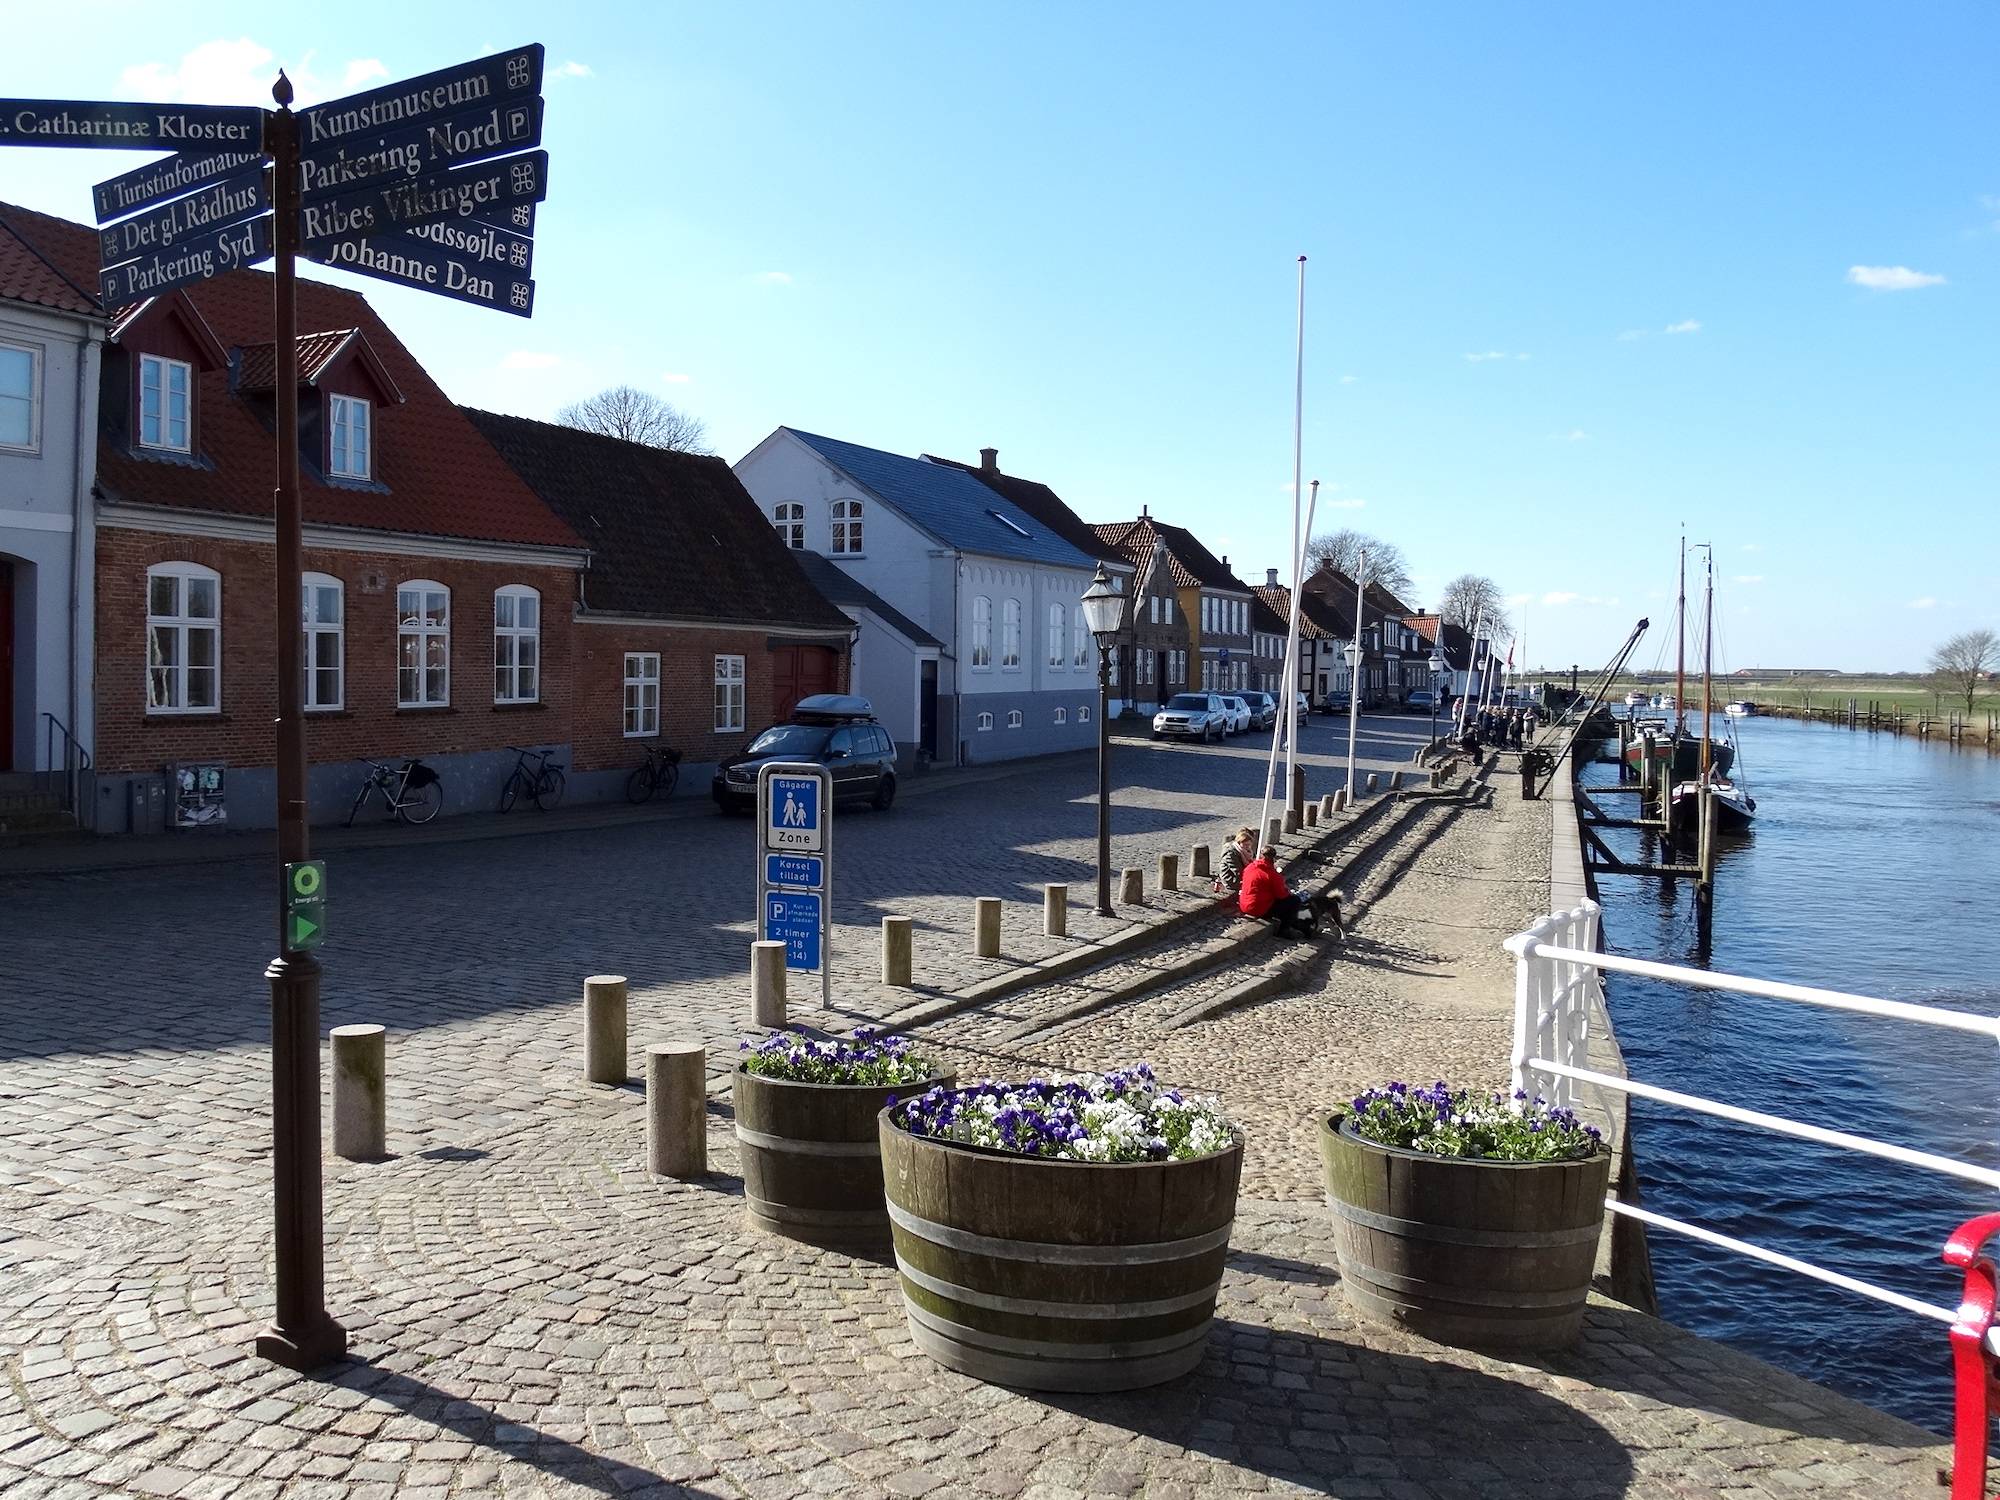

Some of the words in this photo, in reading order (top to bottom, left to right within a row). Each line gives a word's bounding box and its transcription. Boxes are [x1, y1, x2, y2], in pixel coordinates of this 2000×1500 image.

[308, 73, 491, 143] Kunstmuseum
[15, 111, 151, 138] Catharinæ
[156, 114, 251, 141] Kloster
[300, 138, 420, 193] Parkering
[426, 108, 502, 161] Nord
[511, 112, 525, 136] P
[123, 217, 157, 252] Det
[162, 211, 183, 247] gl.
[184, 185, 257, 230] Rådhus
[303, 200, 376, 239] Ribes
[380, 176, 501, 221] Vikinger
[407, 221, 507, 262] odssøjle
[107, 278, 116, 298] P
[126, 246, 214, 295] Parkering
[218, 223, 256, 270] Syd
[324, 238, 438, 284] Johanne
[444, 260, 495, 300] Dan
[779, 780, 811, 790] Gågade
[779, 831, 810, 844] Zone
[779, 860, 810, 871] Kørsel
[780, 871, 809, 882] tilladt
[773, 903, 784, 919] P
[775, 927, 781, 936] 2
[784, 929, 810, 939] timer
[788, 951, 807, 961] -14)
